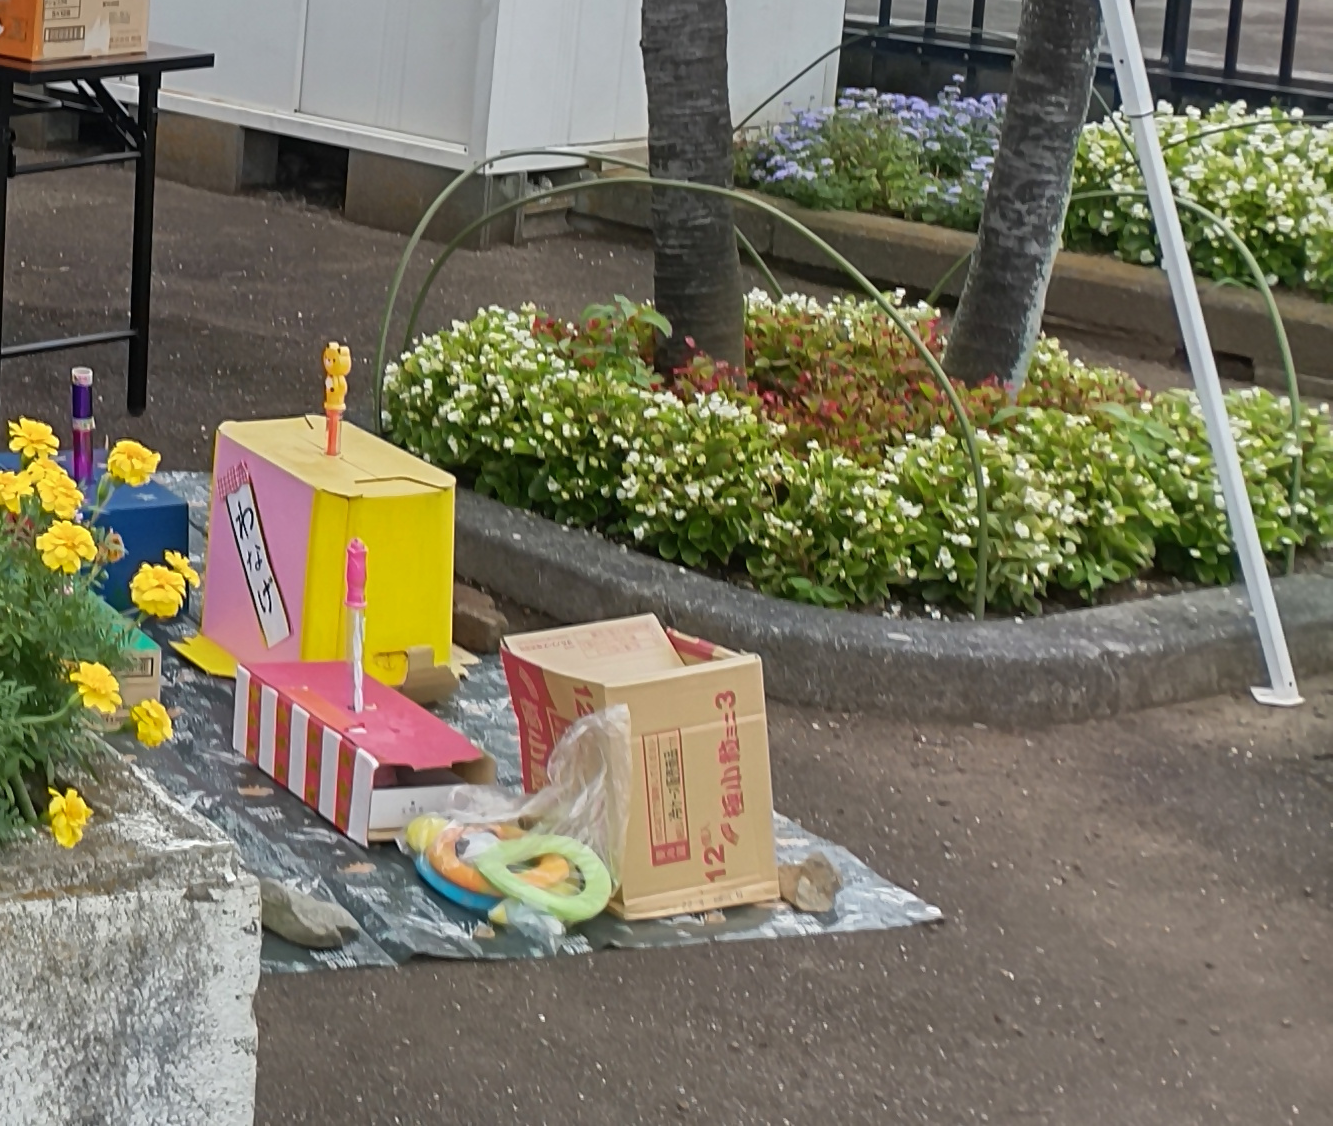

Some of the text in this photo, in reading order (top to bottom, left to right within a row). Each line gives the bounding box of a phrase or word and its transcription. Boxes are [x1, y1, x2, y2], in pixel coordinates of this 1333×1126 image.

[235, 500, 275, 615] わなげ
[704, 843, 727, 883] 12
